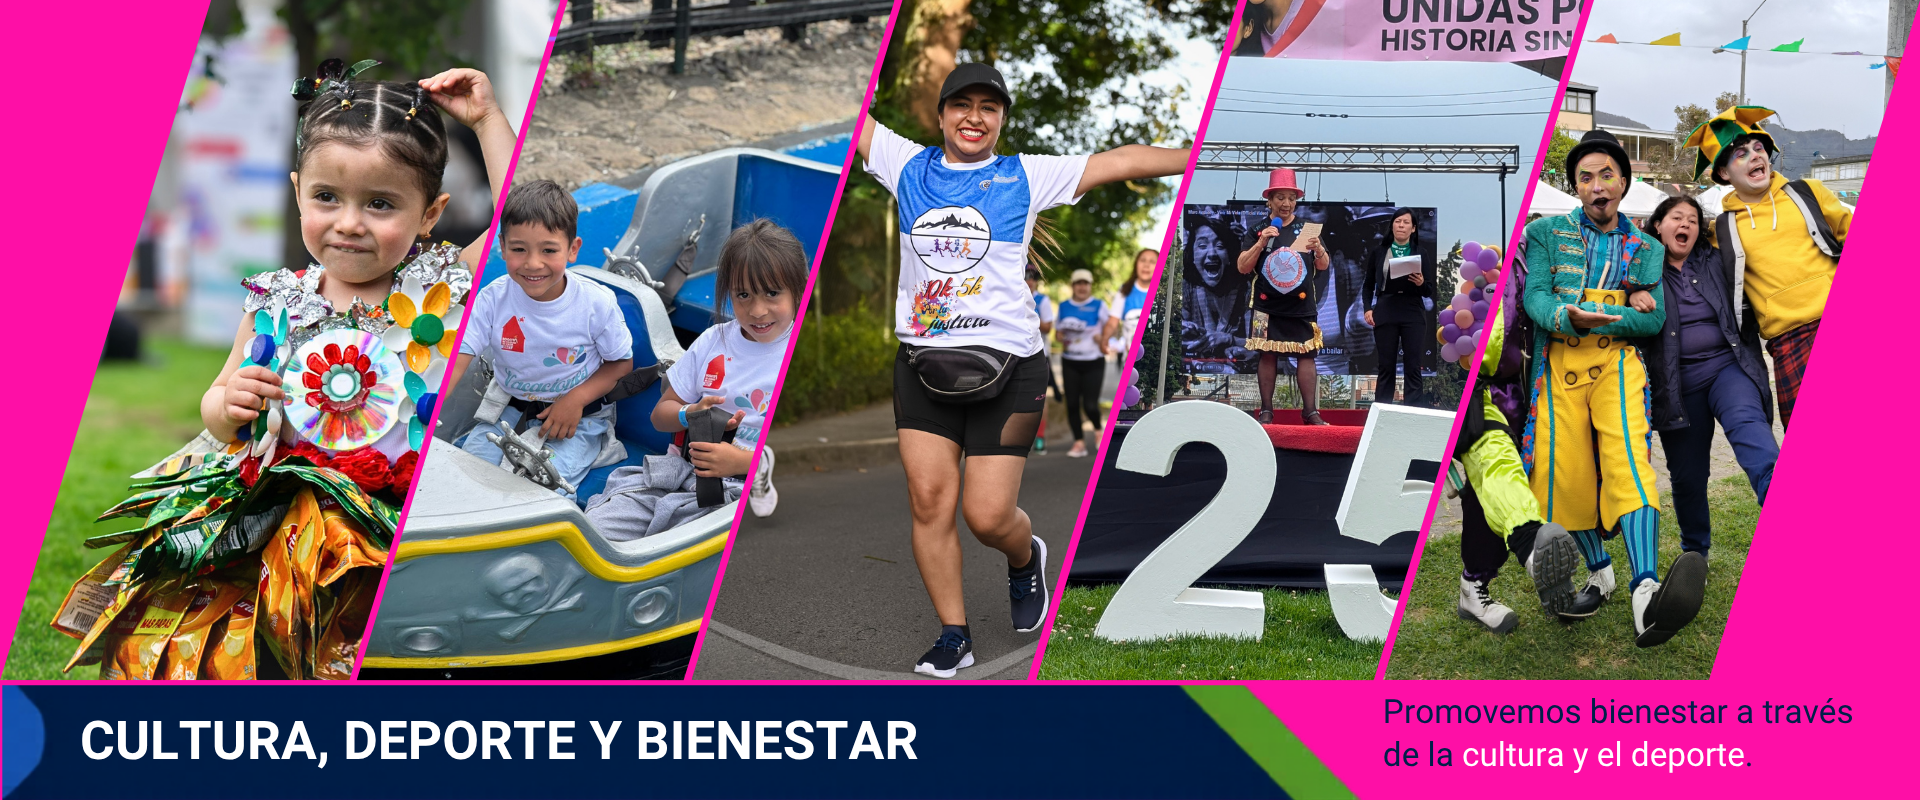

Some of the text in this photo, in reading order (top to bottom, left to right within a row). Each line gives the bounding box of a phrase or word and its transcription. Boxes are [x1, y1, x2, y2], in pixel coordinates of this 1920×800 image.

[1382, 0, 1584, 24] UNIDAS P
[1381, 29, 1572, 52] HISTORIA SIN
[920, 314, 991, 336] justicia
[139, 616, 176, 629] MÁS PAPAS
